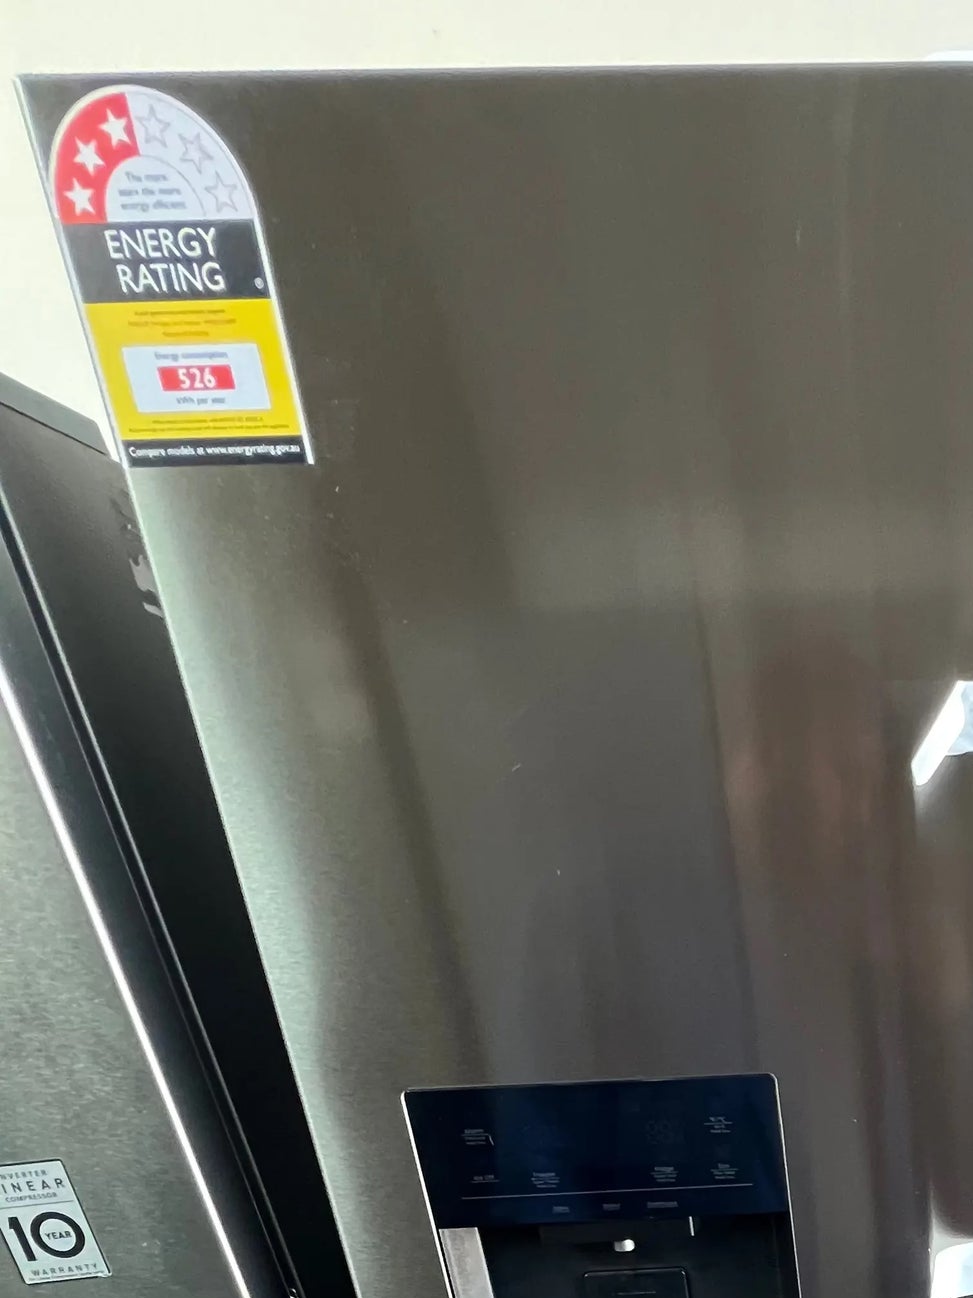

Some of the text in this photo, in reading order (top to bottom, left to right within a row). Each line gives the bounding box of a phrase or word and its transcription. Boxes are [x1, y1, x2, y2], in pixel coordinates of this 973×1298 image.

[104, 227, 216, 260] ENERGY
[116, 262, 226, 294] RATING
[178, 367, 216, 389] 526
[129, 446, 165, 458] Compare
[8, 1211, 86, 1262] 10
[45, 1231, 72, 1241] YEAR
[31, 1263, 98, 1277] WARRANTY
